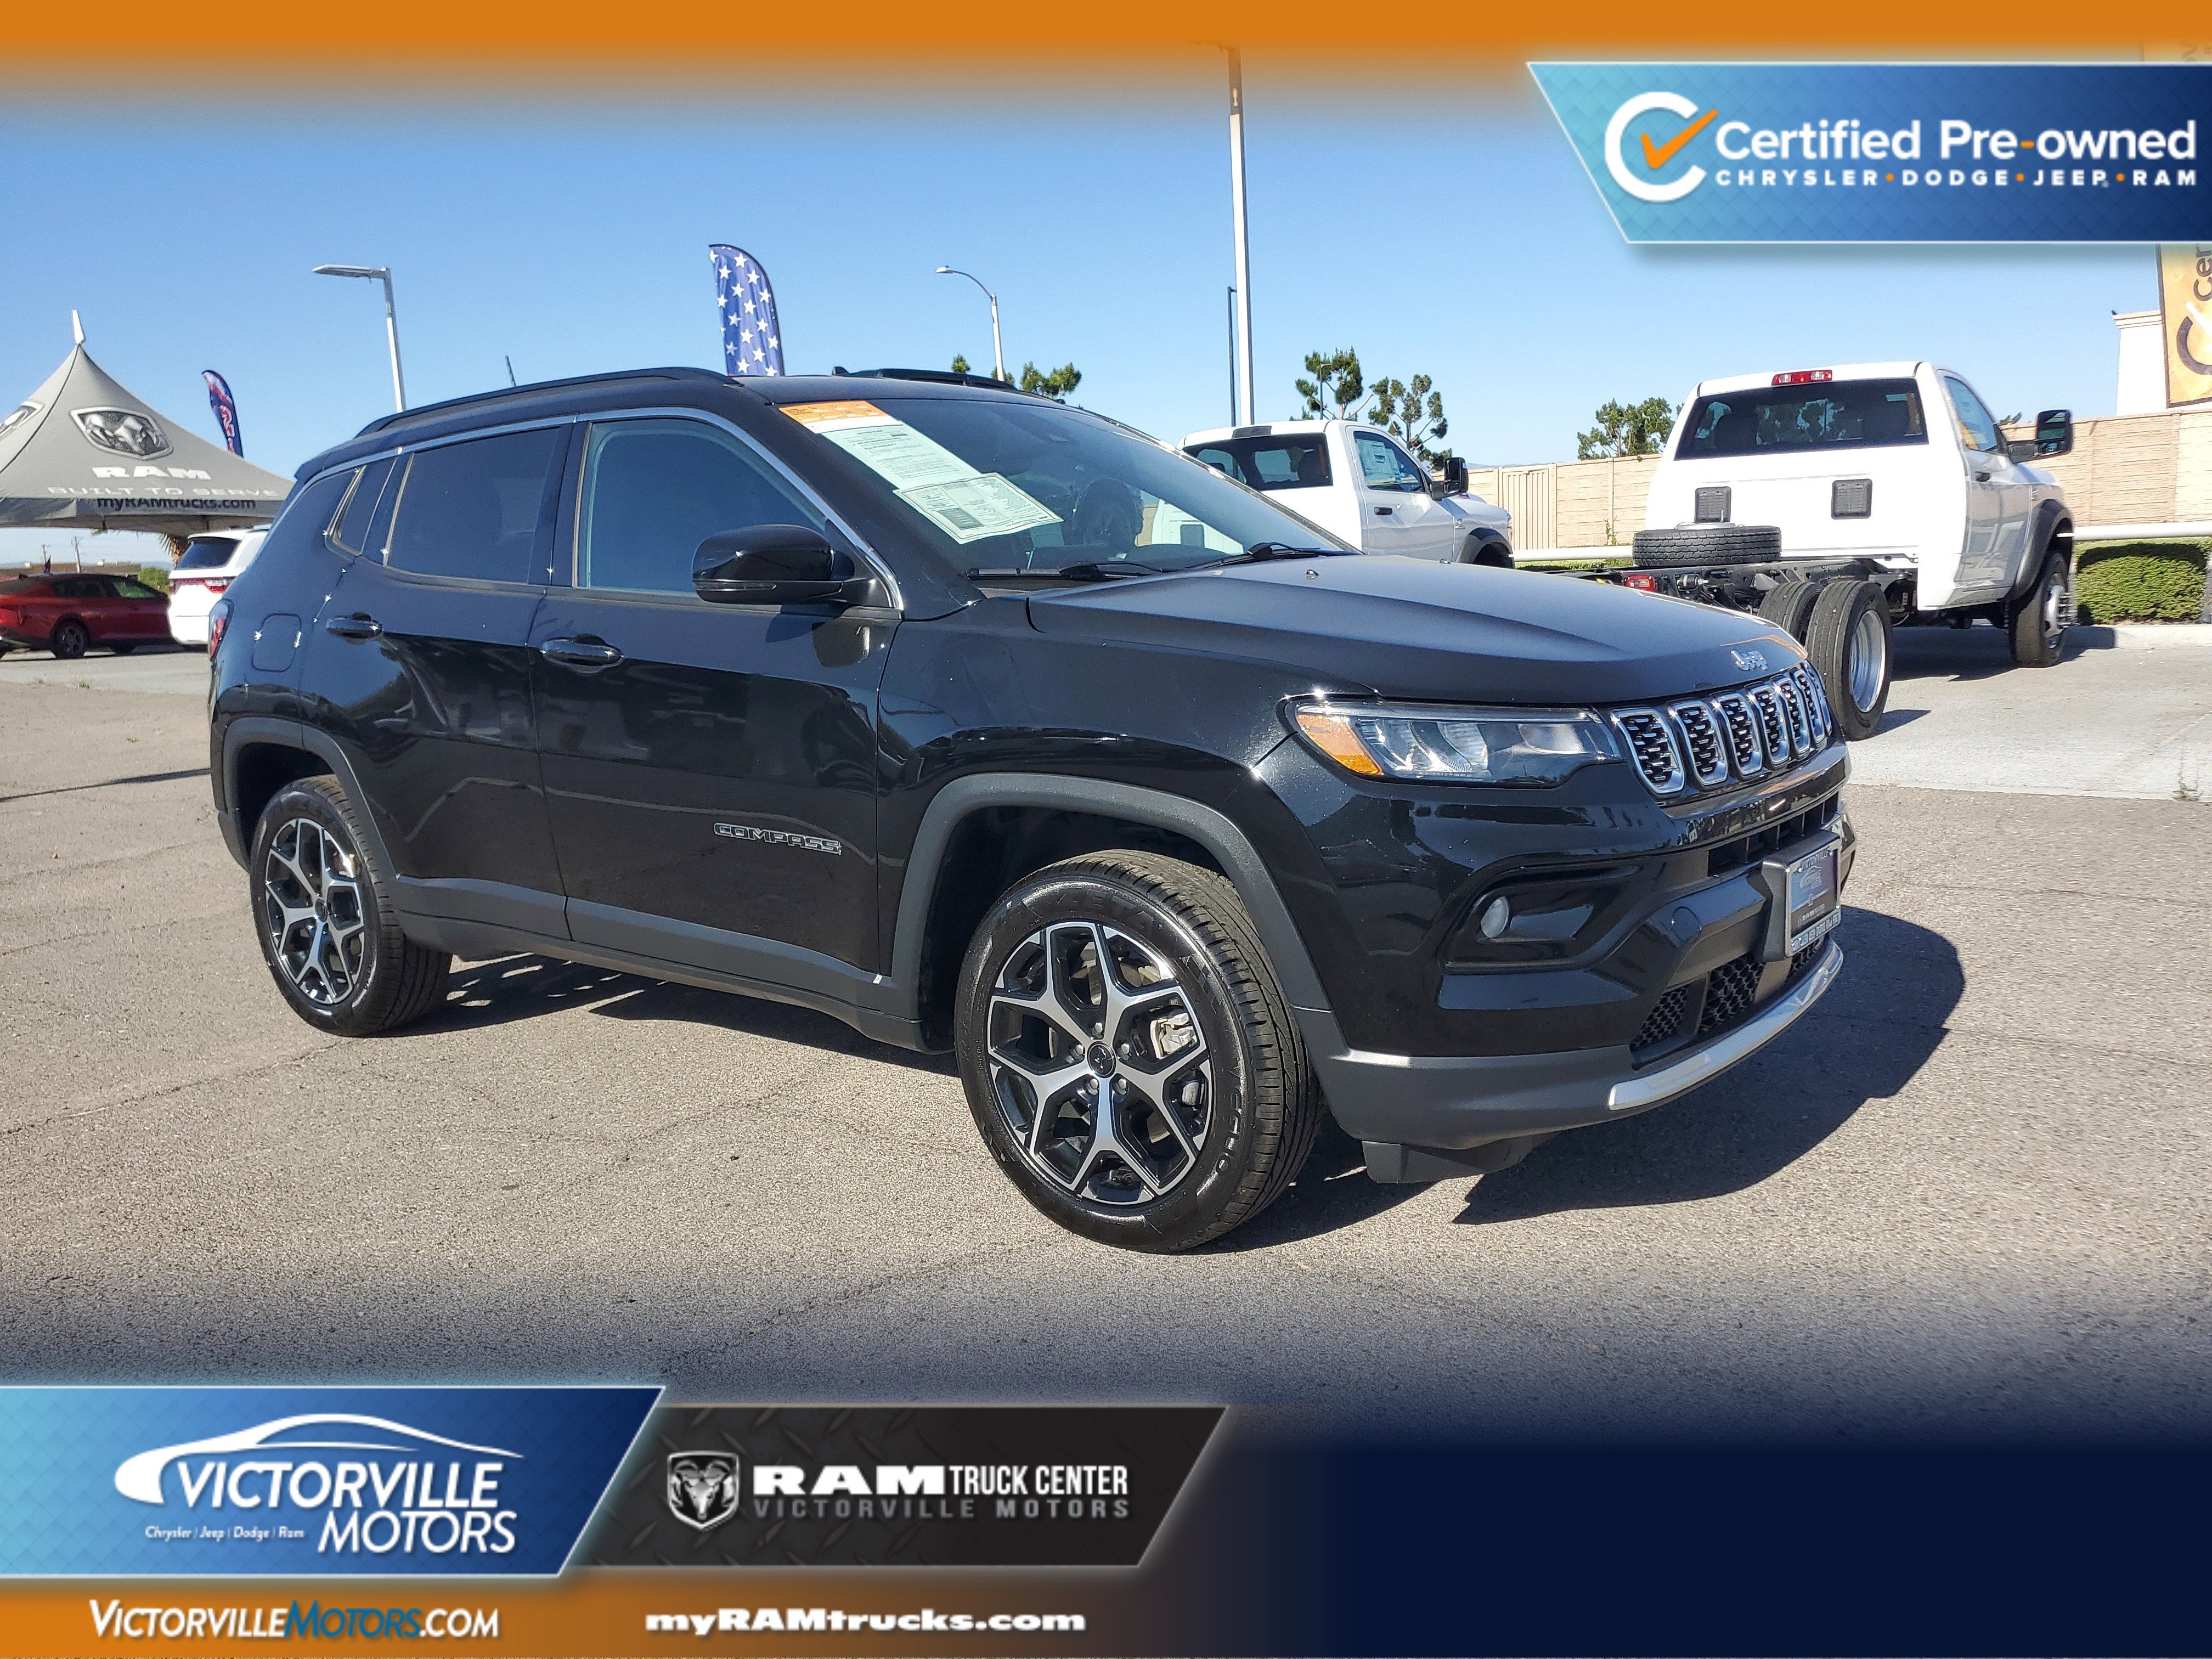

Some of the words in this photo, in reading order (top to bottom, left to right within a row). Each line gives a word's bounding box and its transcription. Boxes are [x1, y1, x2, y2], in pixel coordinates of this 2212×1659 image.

[92, 466, 212, 481] RAM
[47, 487, 134, 495] BUILT
[144, 487, 183, 495] TO
[97, 498, 257, 512] myRAMtrucks.com
[713, 822, 842, 855] COMPASS
